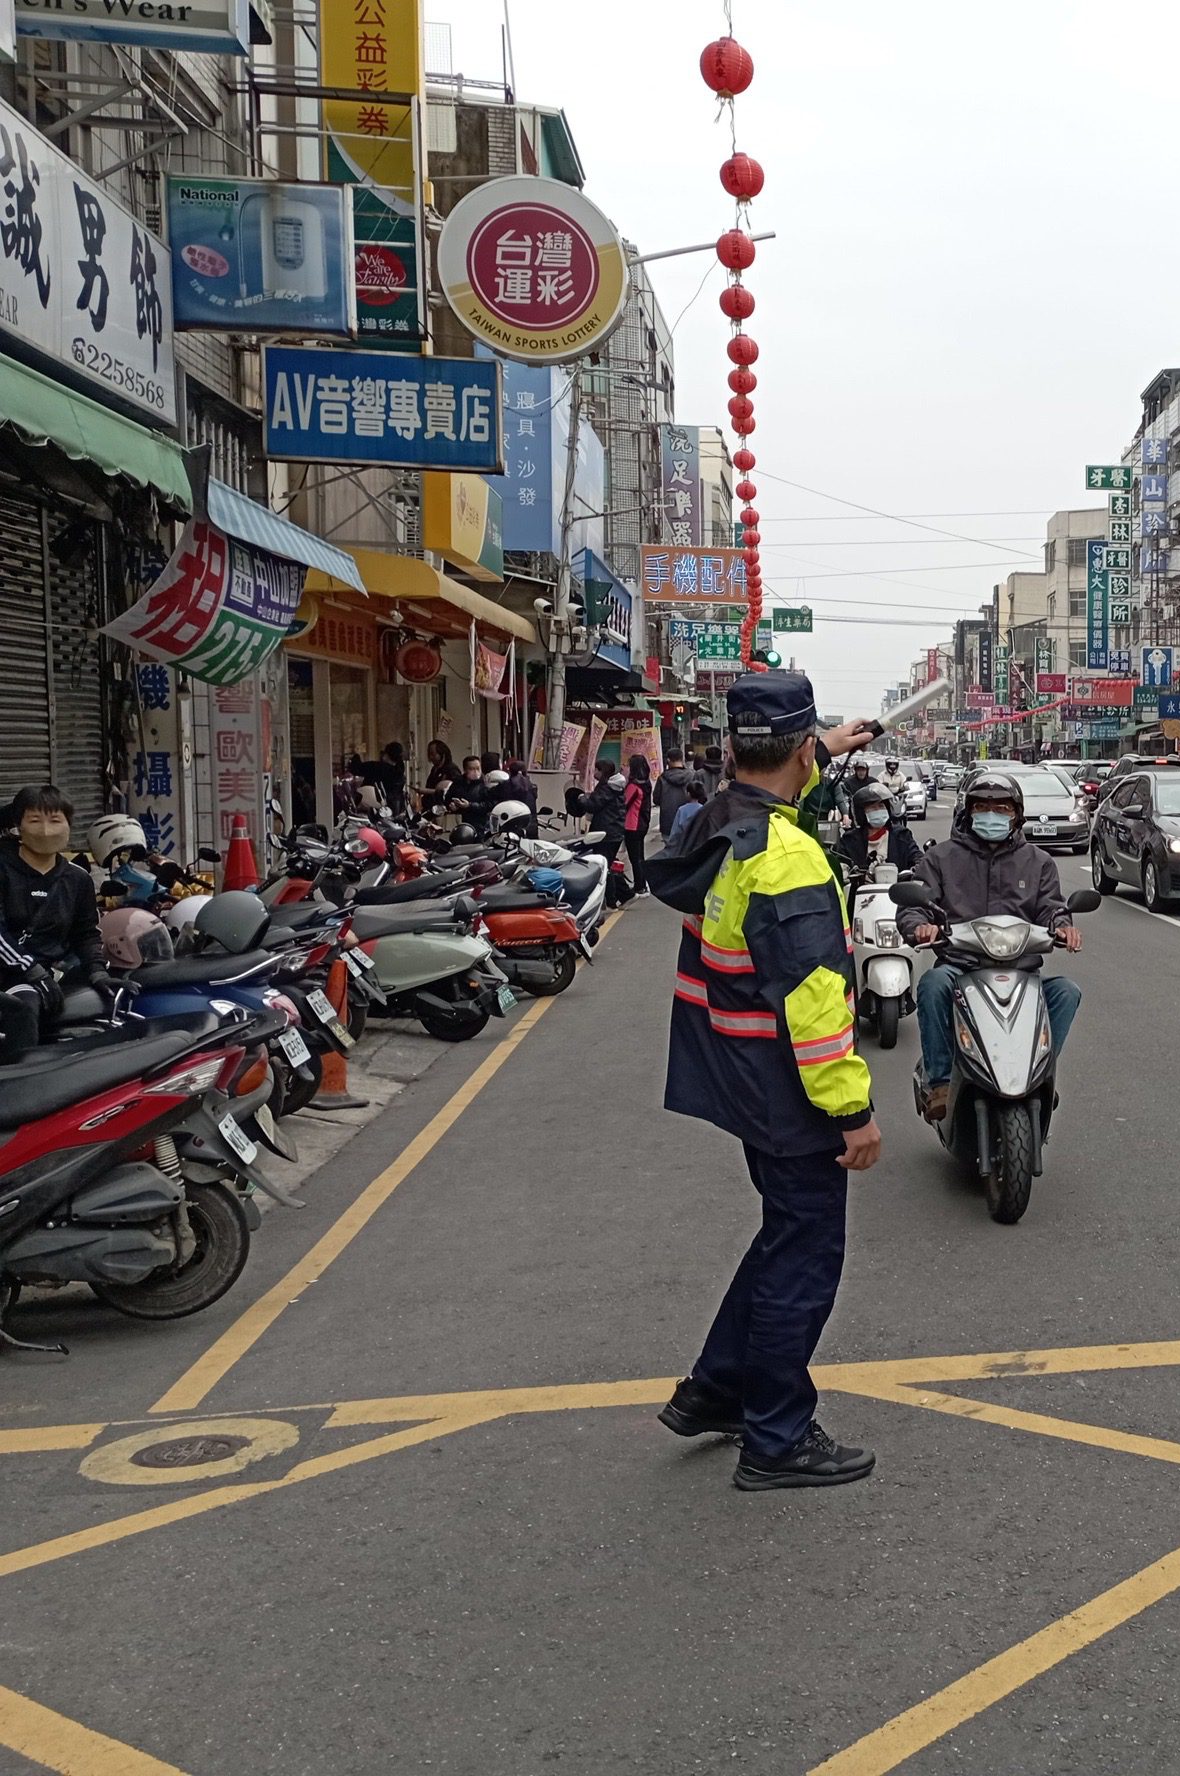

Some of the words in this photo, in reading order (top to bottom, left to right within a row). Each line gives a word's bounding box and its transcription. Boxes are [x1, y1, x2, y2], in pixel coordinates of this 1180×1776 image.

[354, 0, 390, 135] 公益彩券
[180, 187, 239, 202] National
[495, 229, 573, 268] 台灣
[494, 267, 576, 306] 運彩
[468, 308, 512, 343] TAIWAN
[514, 335, 559, 350] SPORTS
[561, 313, 602, 347] LOTTERY
[87, 344, 165, 409] 2258568
[271, 371, 492, 442] AV音響專賣店
[129, 522, 228, 656] 租
[643, 551, 748, 598] 手機配件
